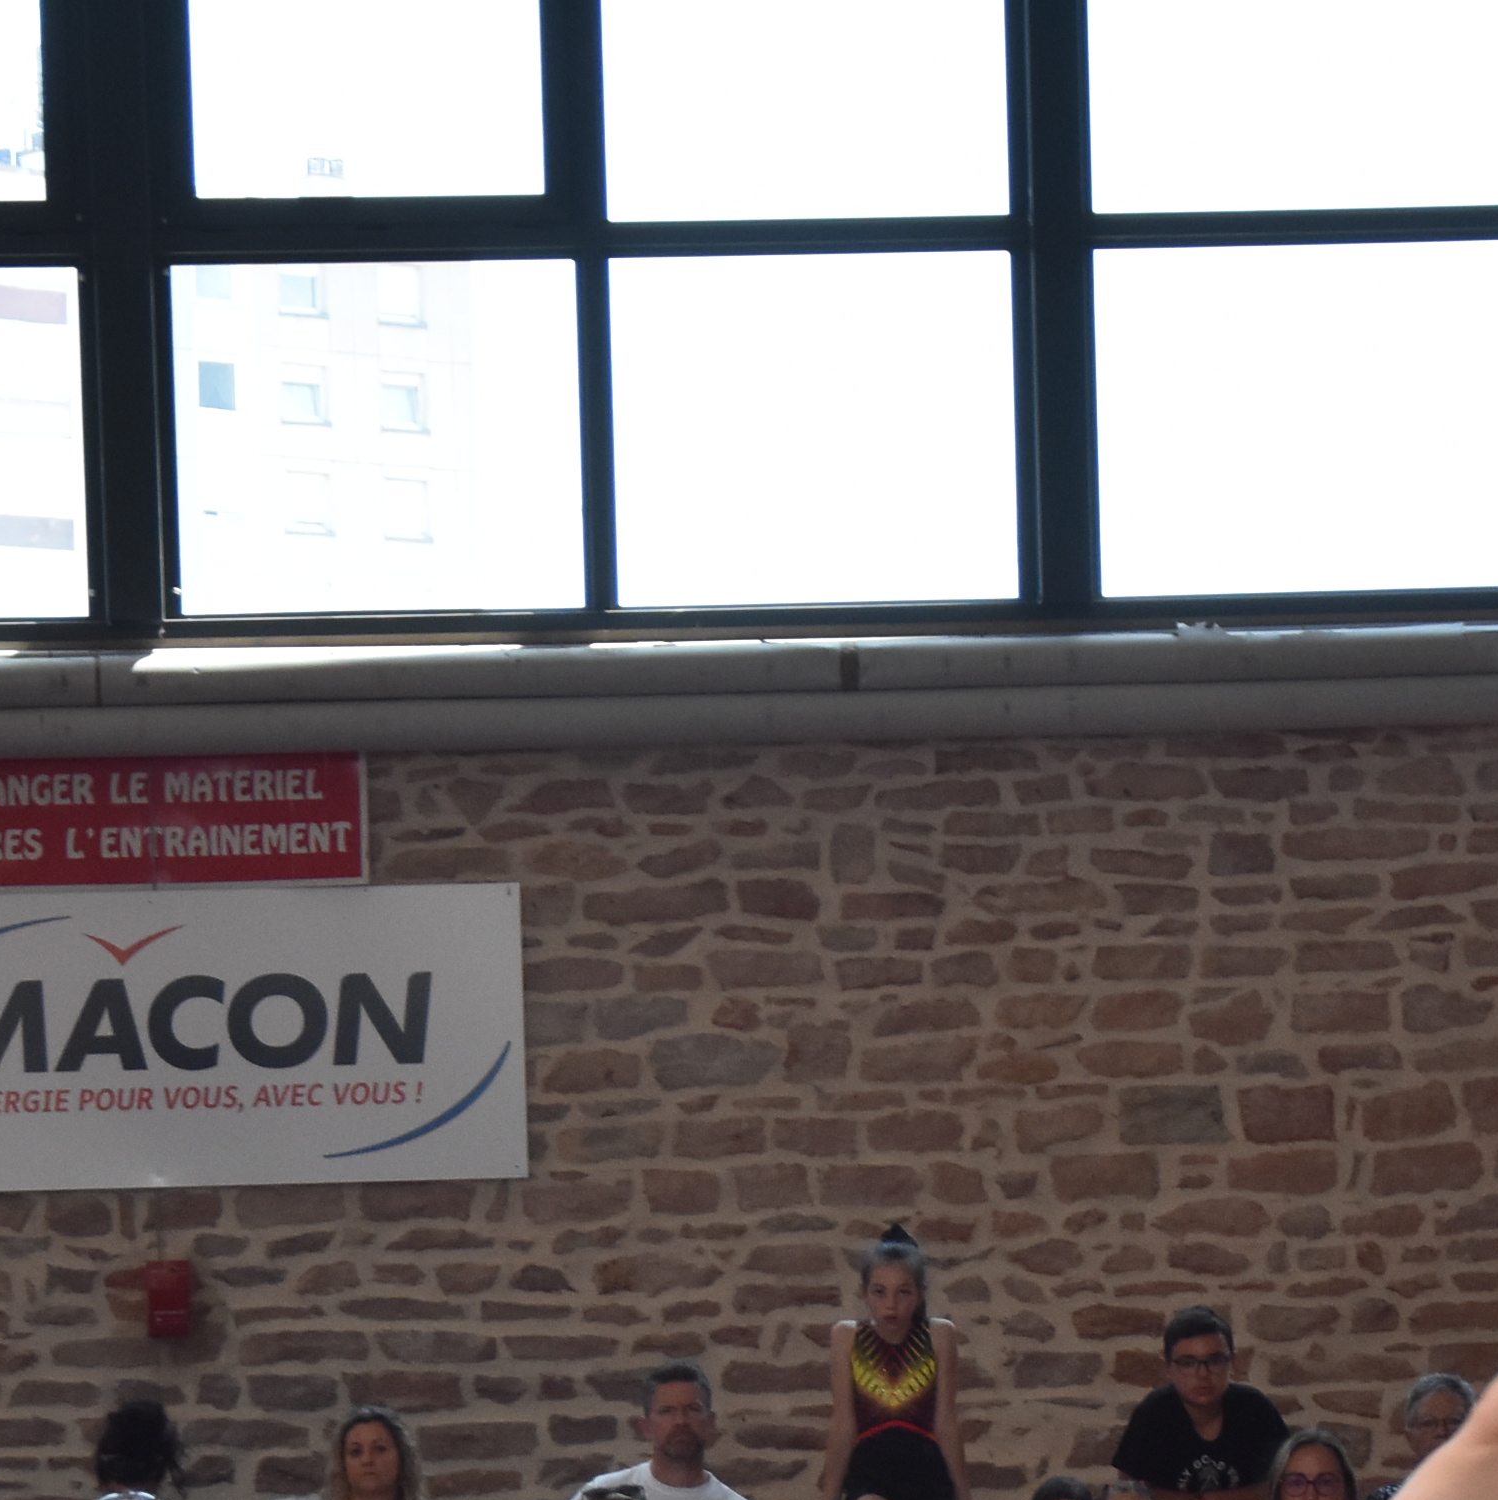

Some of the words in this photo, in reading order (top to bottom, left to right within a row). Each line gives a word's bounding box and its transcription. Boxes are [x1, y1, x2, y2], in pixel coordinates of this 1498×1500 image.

[109, 772, 149, 804] LE
[164, 769, 324, 803] MATERIEL
[65, 821, 352, 859] L'ENTRAINEMENT
[78, 1087, 154, 1112] POUR
[163, 1085, 244, 1112] VOUS,
[253, 1083, 323, 1108] AVEC
[333, 1081, 406, 1106] VOUS
